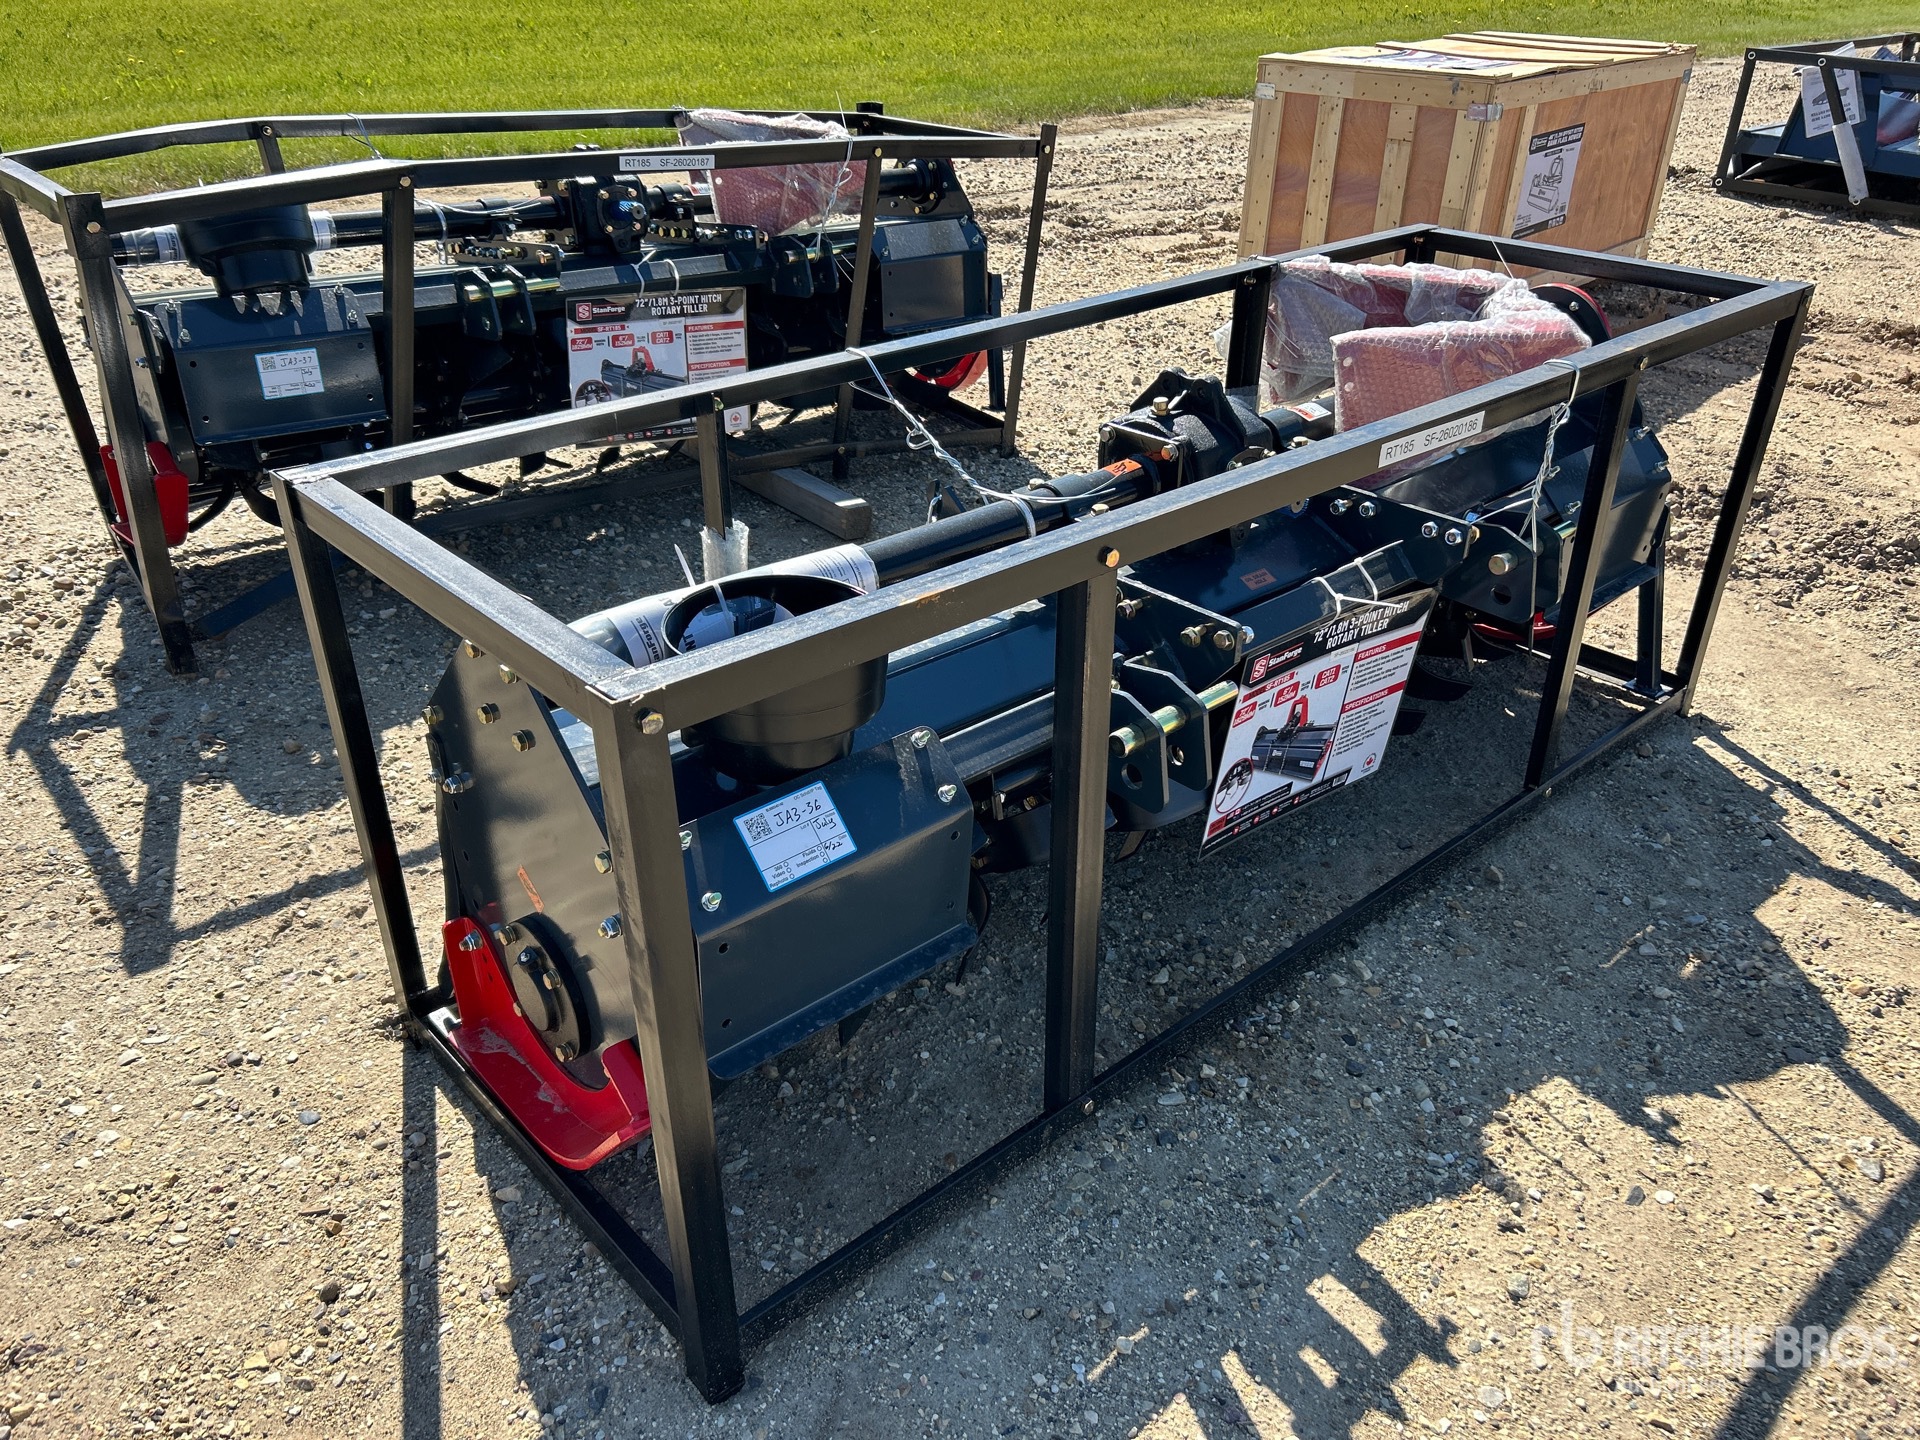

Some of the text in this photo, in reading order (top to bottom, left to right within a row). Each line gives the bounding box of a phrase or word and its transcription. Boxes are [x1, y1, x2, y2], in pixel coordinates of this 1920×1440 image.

[625, 158, 710, 167] RT185 SF-26020187
[635, 293, 722, 308] 72"/1.8M 3-POINT HITCH
[592, 305, 626, 315] StanForge
[651, 303, 708, 316] ROTARY TILLER
[688, 324, 714, 332] FEATURES
[280, 356, 312, 367] JA3-37
[690, 361, 731, 370] SPECIFICATIONS
[1385, 419, 1478, 460] RT185 SF-26020186
[1313, 600, 1410, 644] 72"/1.8M 3-POINT HITCH
[1326, 618, 1389, 650] ROTARY TILLER
[1268, 647, 1303, 667] StanForge
[1358, 644, 1387, 660] FEATURES
[1321, 667, 1337, 679] CAT1
[1265, 674, 1291, 691] SF-RT185
[1319, 675, 1335, 686] CAT2
[1344, 689, 1389, 711] SPECIFICATIONS
[773, 799, 822, 827] JA3-36
[812, 817, 837, 830] July
[824, 841, 843, 851] 6/22
[802, 848, 817, 858] Fluids
[796, 854, 820, 868] Inspection
[771, 870, 786, 879] Video
